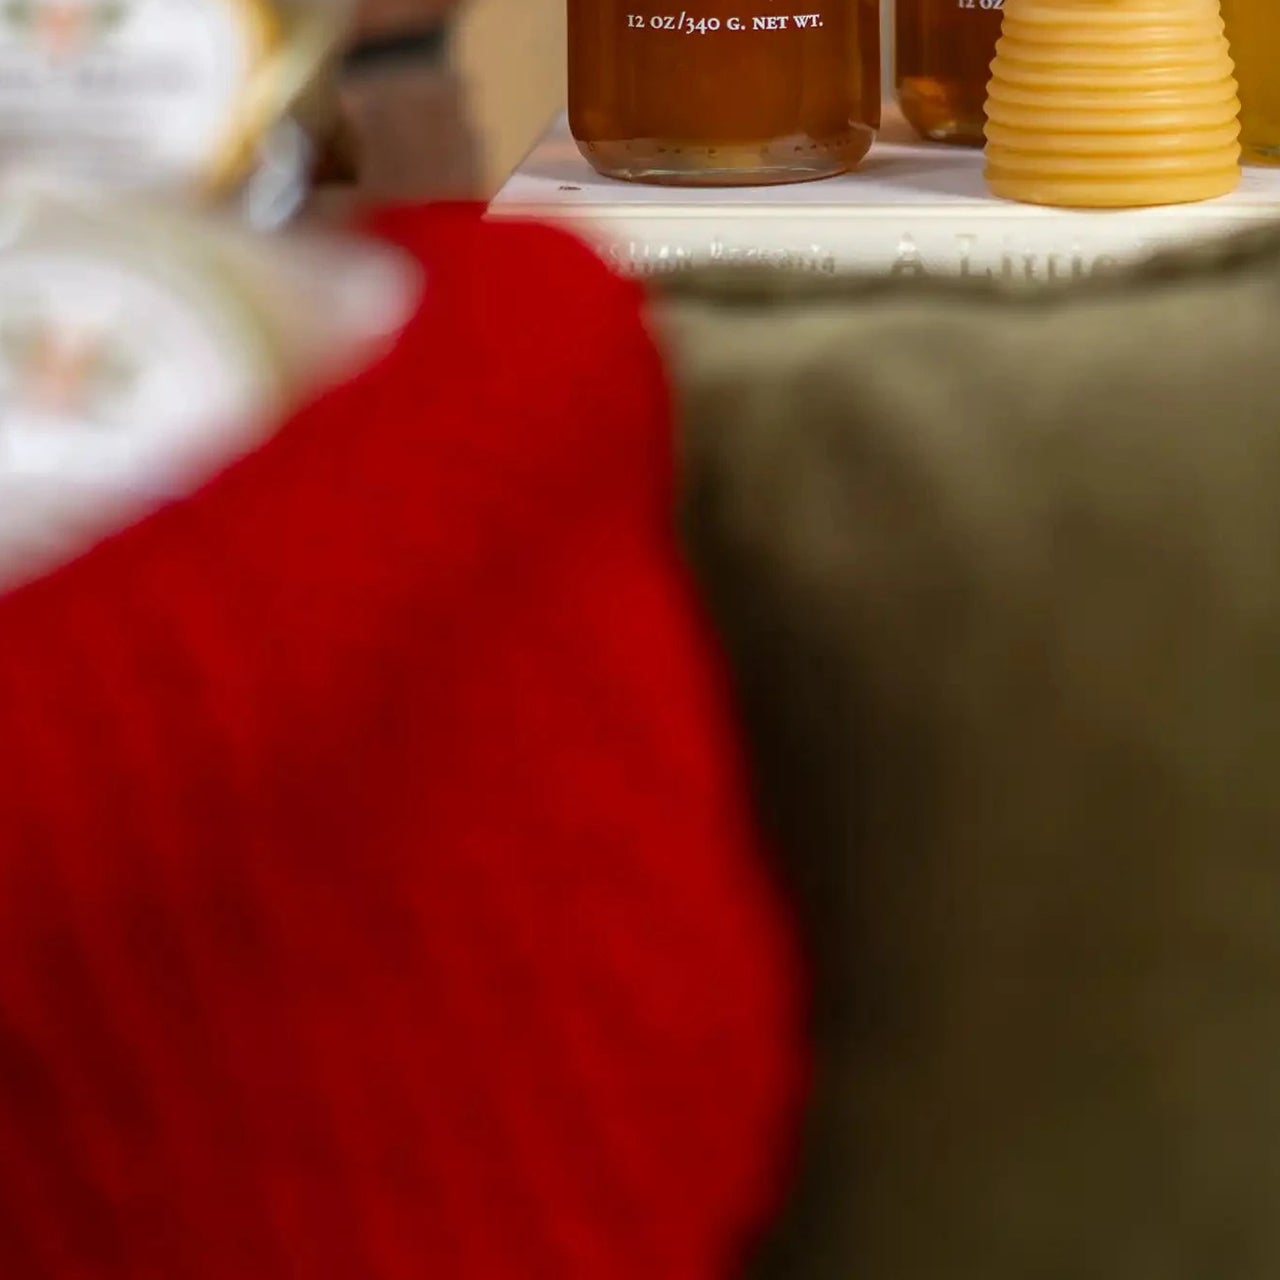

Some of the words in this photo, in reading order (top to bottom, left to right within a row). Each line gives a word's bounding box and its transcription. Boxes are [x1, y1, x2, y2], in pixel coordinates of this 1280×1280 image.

[628, 15, 645, 27] 12
[727, 18, 745, 30] G.
[752, 16, 788, 30] NET
[793, 14, 823, 28] WT.
